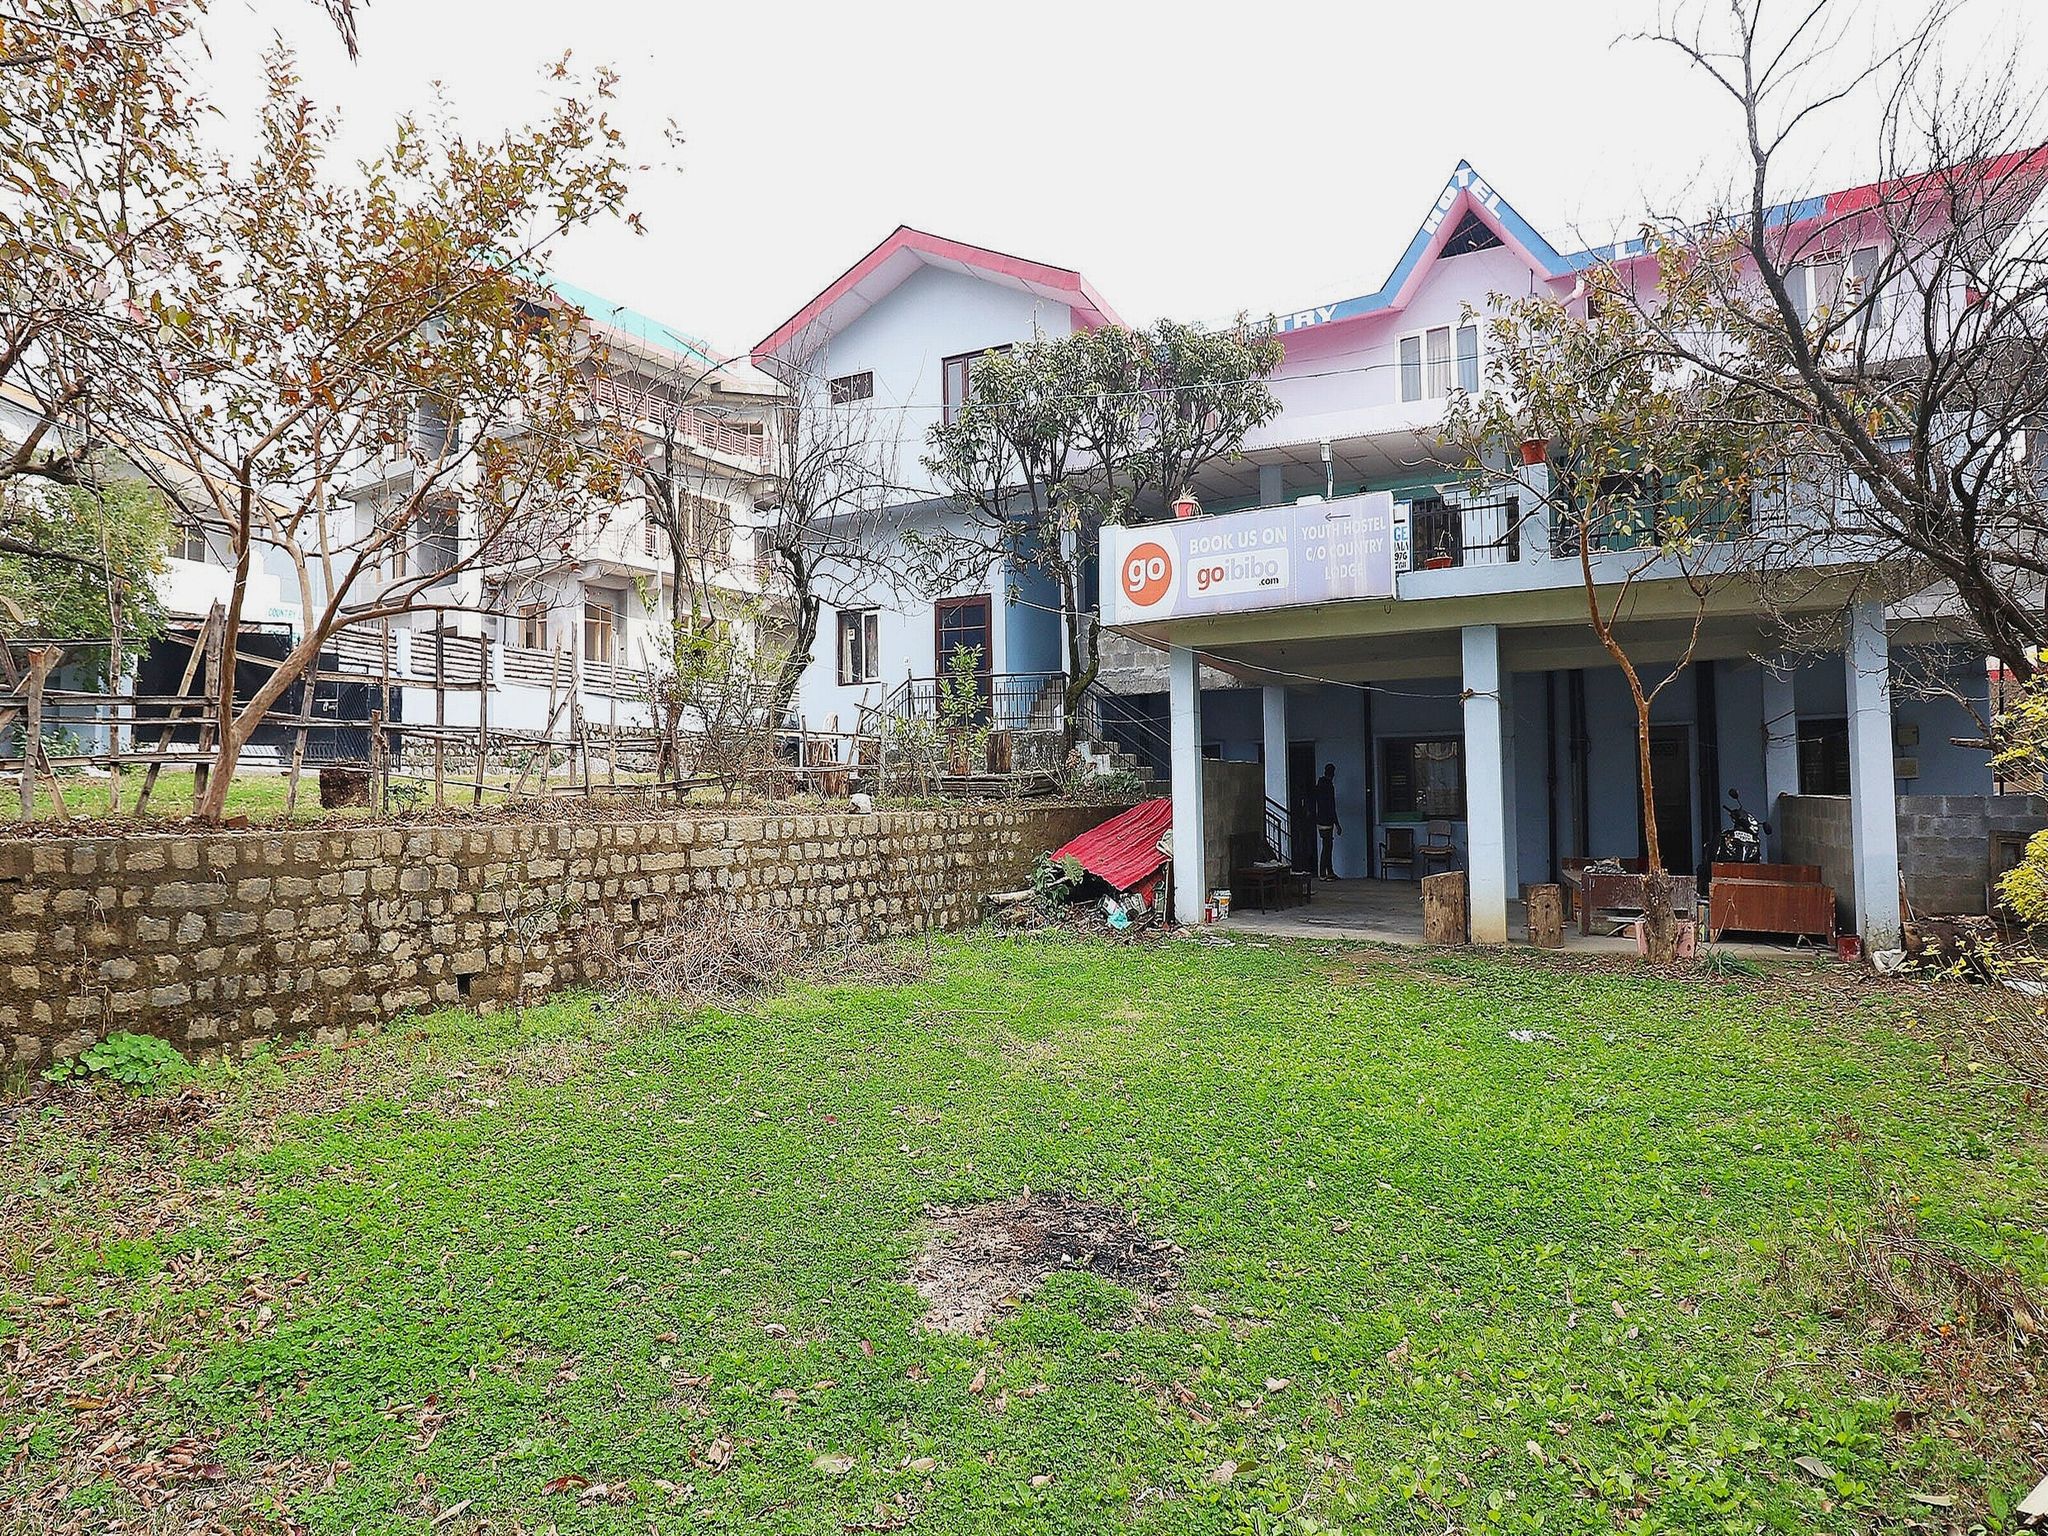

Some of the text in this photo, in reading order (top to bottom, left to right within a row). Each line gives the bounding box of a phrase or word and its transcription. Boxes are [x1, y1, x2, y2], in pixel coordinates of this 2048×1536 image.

[1422, 167, 1502, 236] HOTEL
[1267, 303, 1338, 334] TRY
[1189, 526, 1287, 554] BOOK US ON
[1301, 516, 1387, 541] YOUTH HOSTEL
[1393, 526, 1408, 542] GE
[1305, 538, 1384, 563] C/O COUNTRY
[1393, 551, 1408, 562] 976
[1128, 557, 1166, 592] go
[1197, 555, 1279, 591] goibibo
[1324, 562, 1364, 581] LODGE
